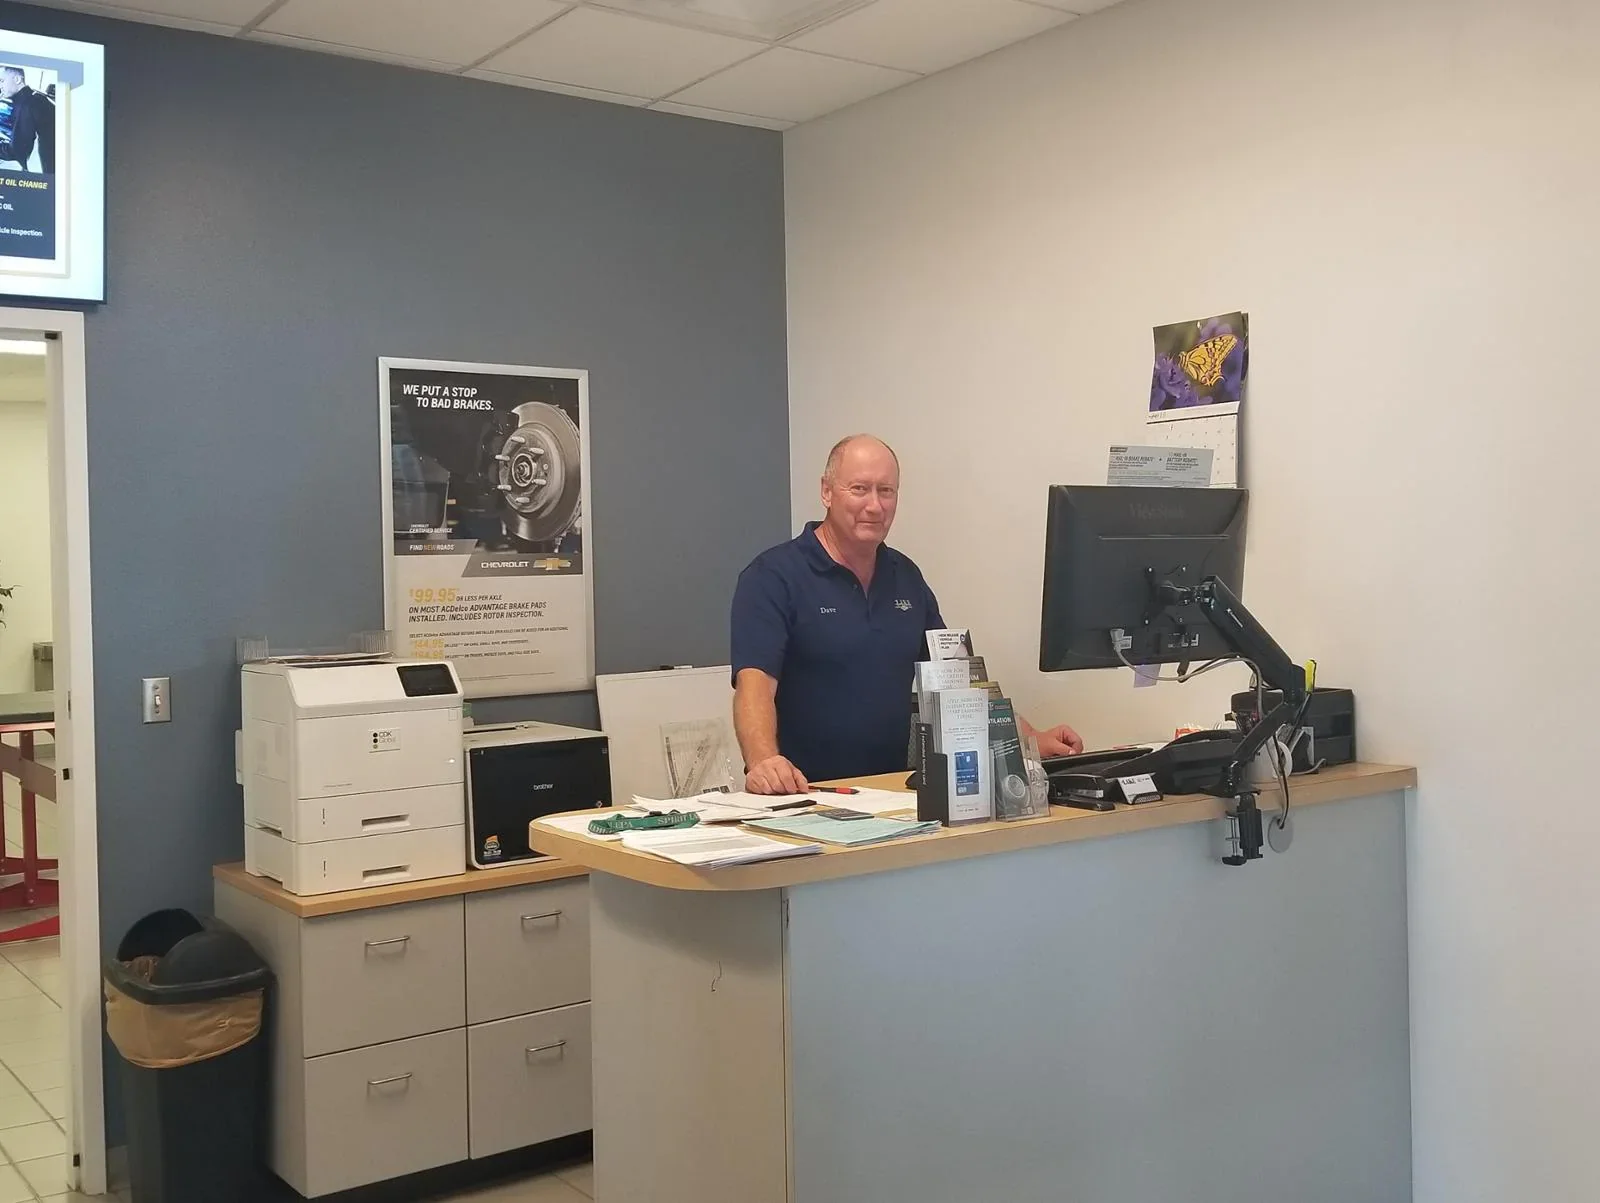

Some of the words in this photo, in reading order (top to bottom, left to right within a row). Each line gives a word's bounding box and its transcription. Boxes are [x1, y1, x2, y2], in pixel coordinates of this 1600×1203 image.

[5, 179, 17, 187] OIL
[18, 180, 48, 189] CHANGE
[403, 384, 420, 395] WE
[421, 385, 441, 396] PUT
[442, 386, 450, 397] A
[452, 387, 477, 398] STOP
[416, 397, 429, 408] TO
[431, 398, 451, 409] BAD
[453, 399, 494, 411] BRAKES.
[481, 561, 530, 569] CHEVROLET
[409, 606, 419, 614] ON
[420, 605, 440, 613] MOST
[441, 604, 469, 613] ACDelco
[469, 603, 508, 612] ADVANTAGE
[509, 602, 530, 610] BRAKE
[408, 614, 448, 623] INSTALLED.
[449, 612, 482, 622] INCLUDES
[483, 611, 505, 620] ROTOR
[505, 610, 544, 619] INSPECTION.
[533, 783, 554, 791] brother
